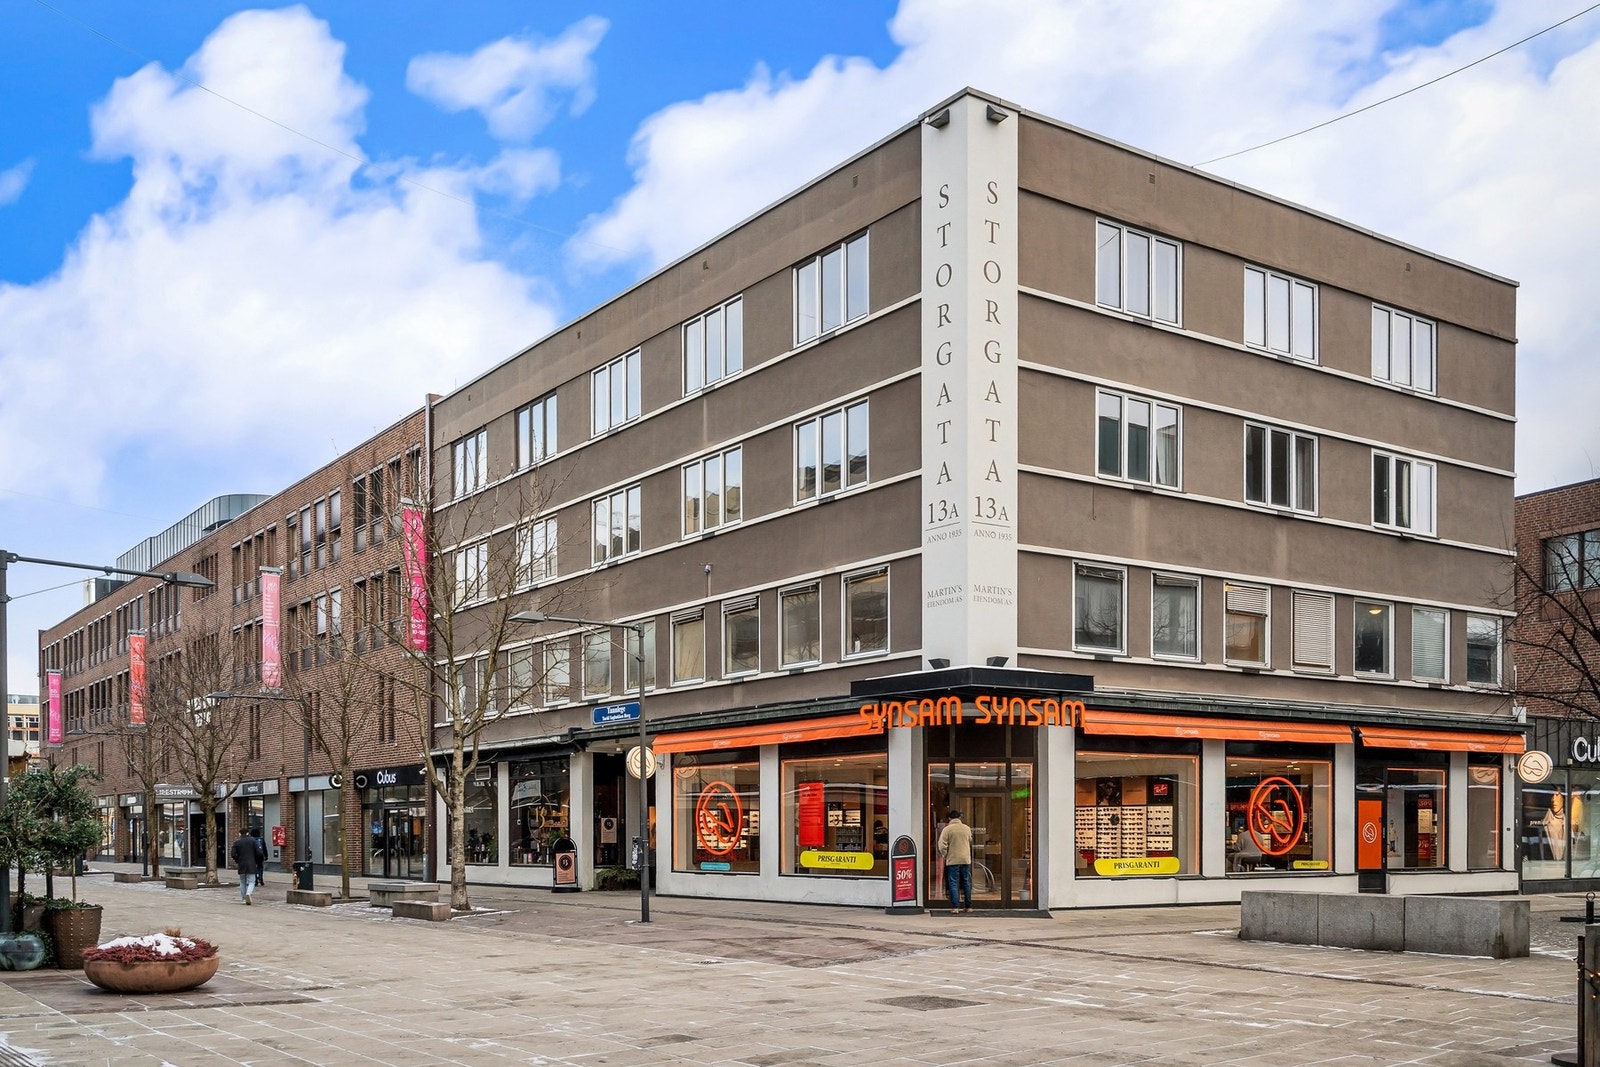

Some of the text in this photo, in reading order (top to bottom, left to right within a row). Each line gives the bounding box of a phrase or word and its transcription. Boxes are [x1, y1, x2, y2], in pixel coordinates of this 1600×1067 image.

[936, 183, 952, 485] STORGATA
[983, 181, 1002, 483] STORGATA
[928, 500, 959, 524] 13A
[975, 496, 1009, 521] 13A
[926, 529, 962, 544] ANNO 1935
[974, 529, 1012, 541] ANNO 1935
[927, 584, 963, 599] MARTIN'S
[974, 584, 1013, 595] MARTIN'S
[860, 696, 1086, 730] SYNSAM SYNSAM
[377, 769, 396, 785] Cubus
[817, 855, 857, 863] PRISGARANTI
[1113, 861, 1160, 869] PRISGARANTI
[896, 869, 913, 880] 50%
